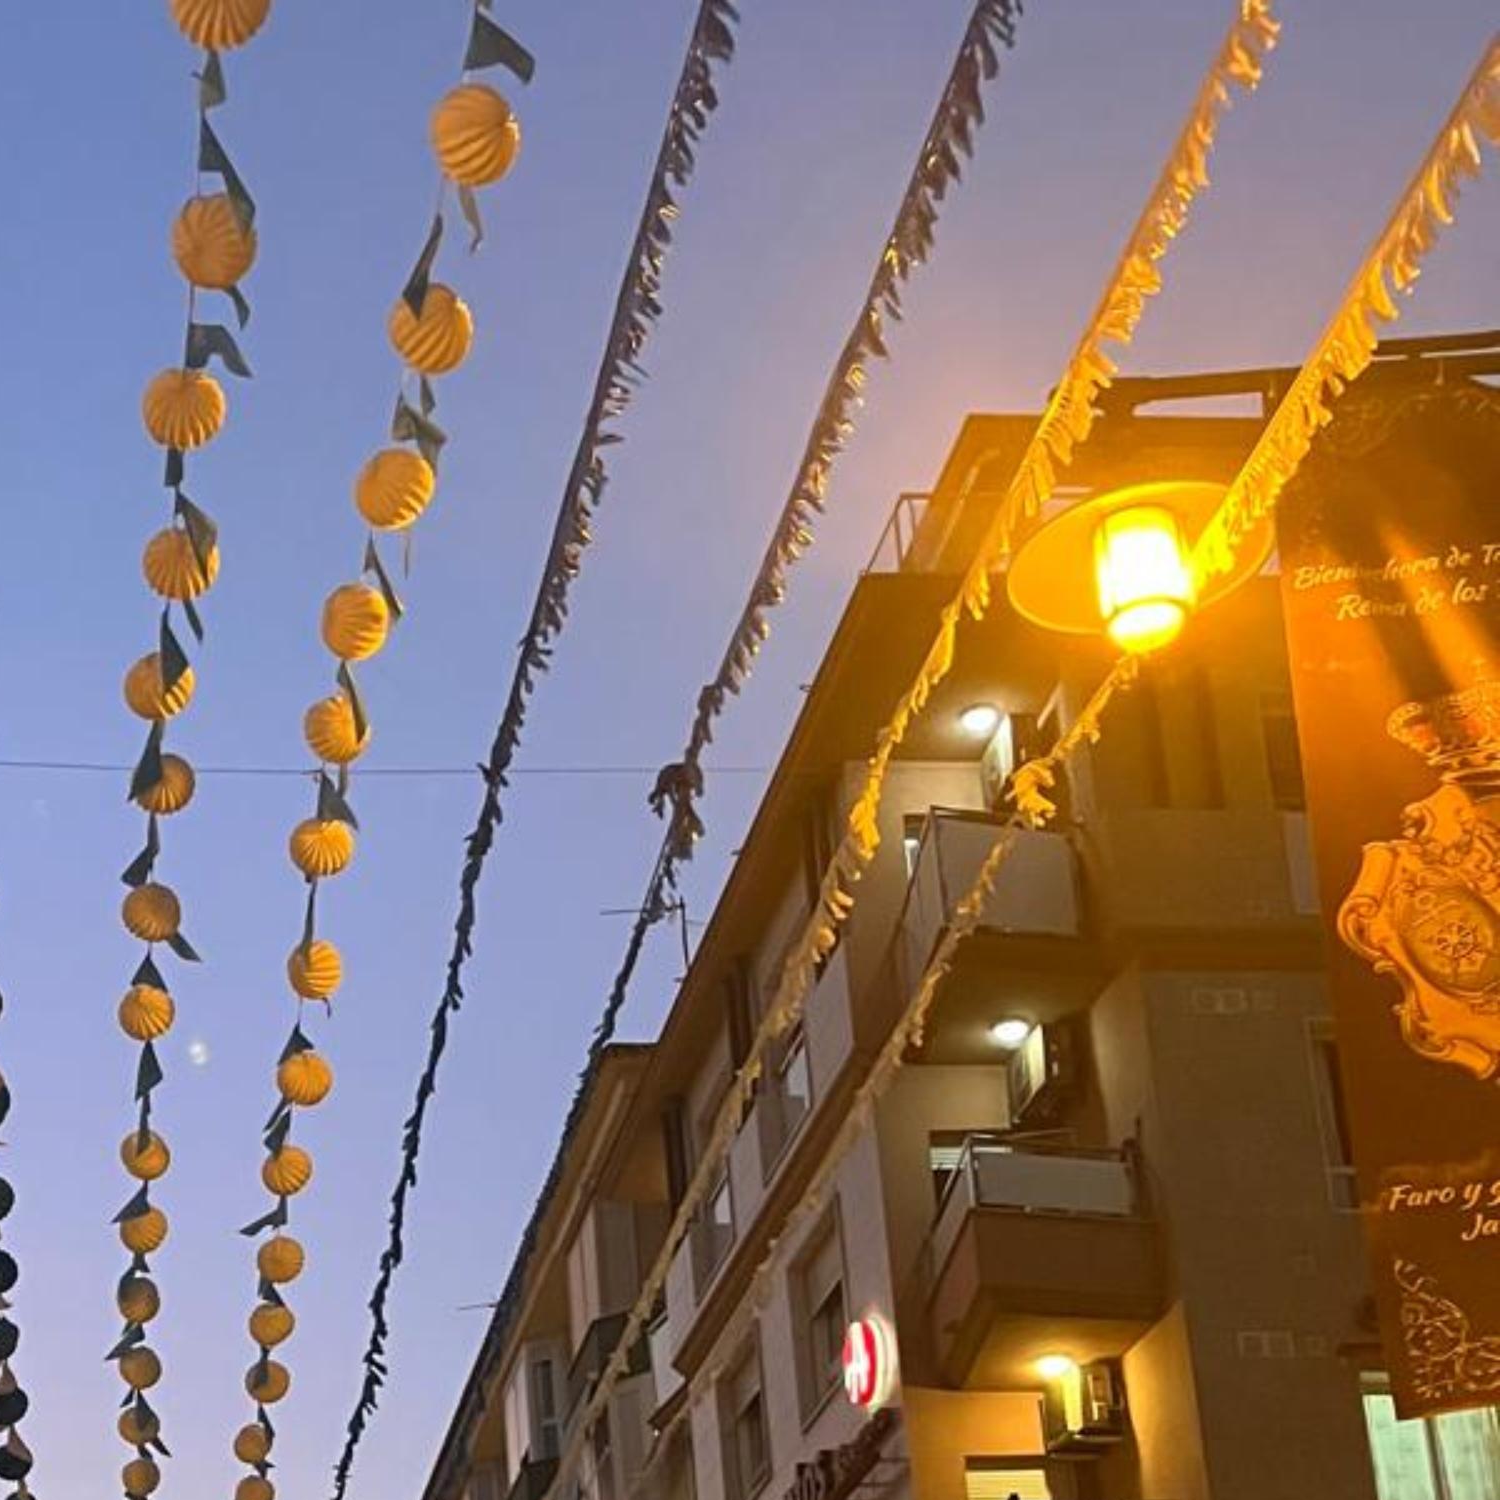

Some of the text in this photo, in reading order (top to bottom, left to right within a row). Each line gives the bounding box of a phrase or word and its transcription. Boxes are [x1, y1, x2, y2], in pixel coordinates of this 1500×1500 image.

[1444, 545, 1471, 568] de
[1414, 586, 1445, 615] de
[1388, 1183, 1456, 1212] Faro
[1460, 1183, 1483, 1211] y
